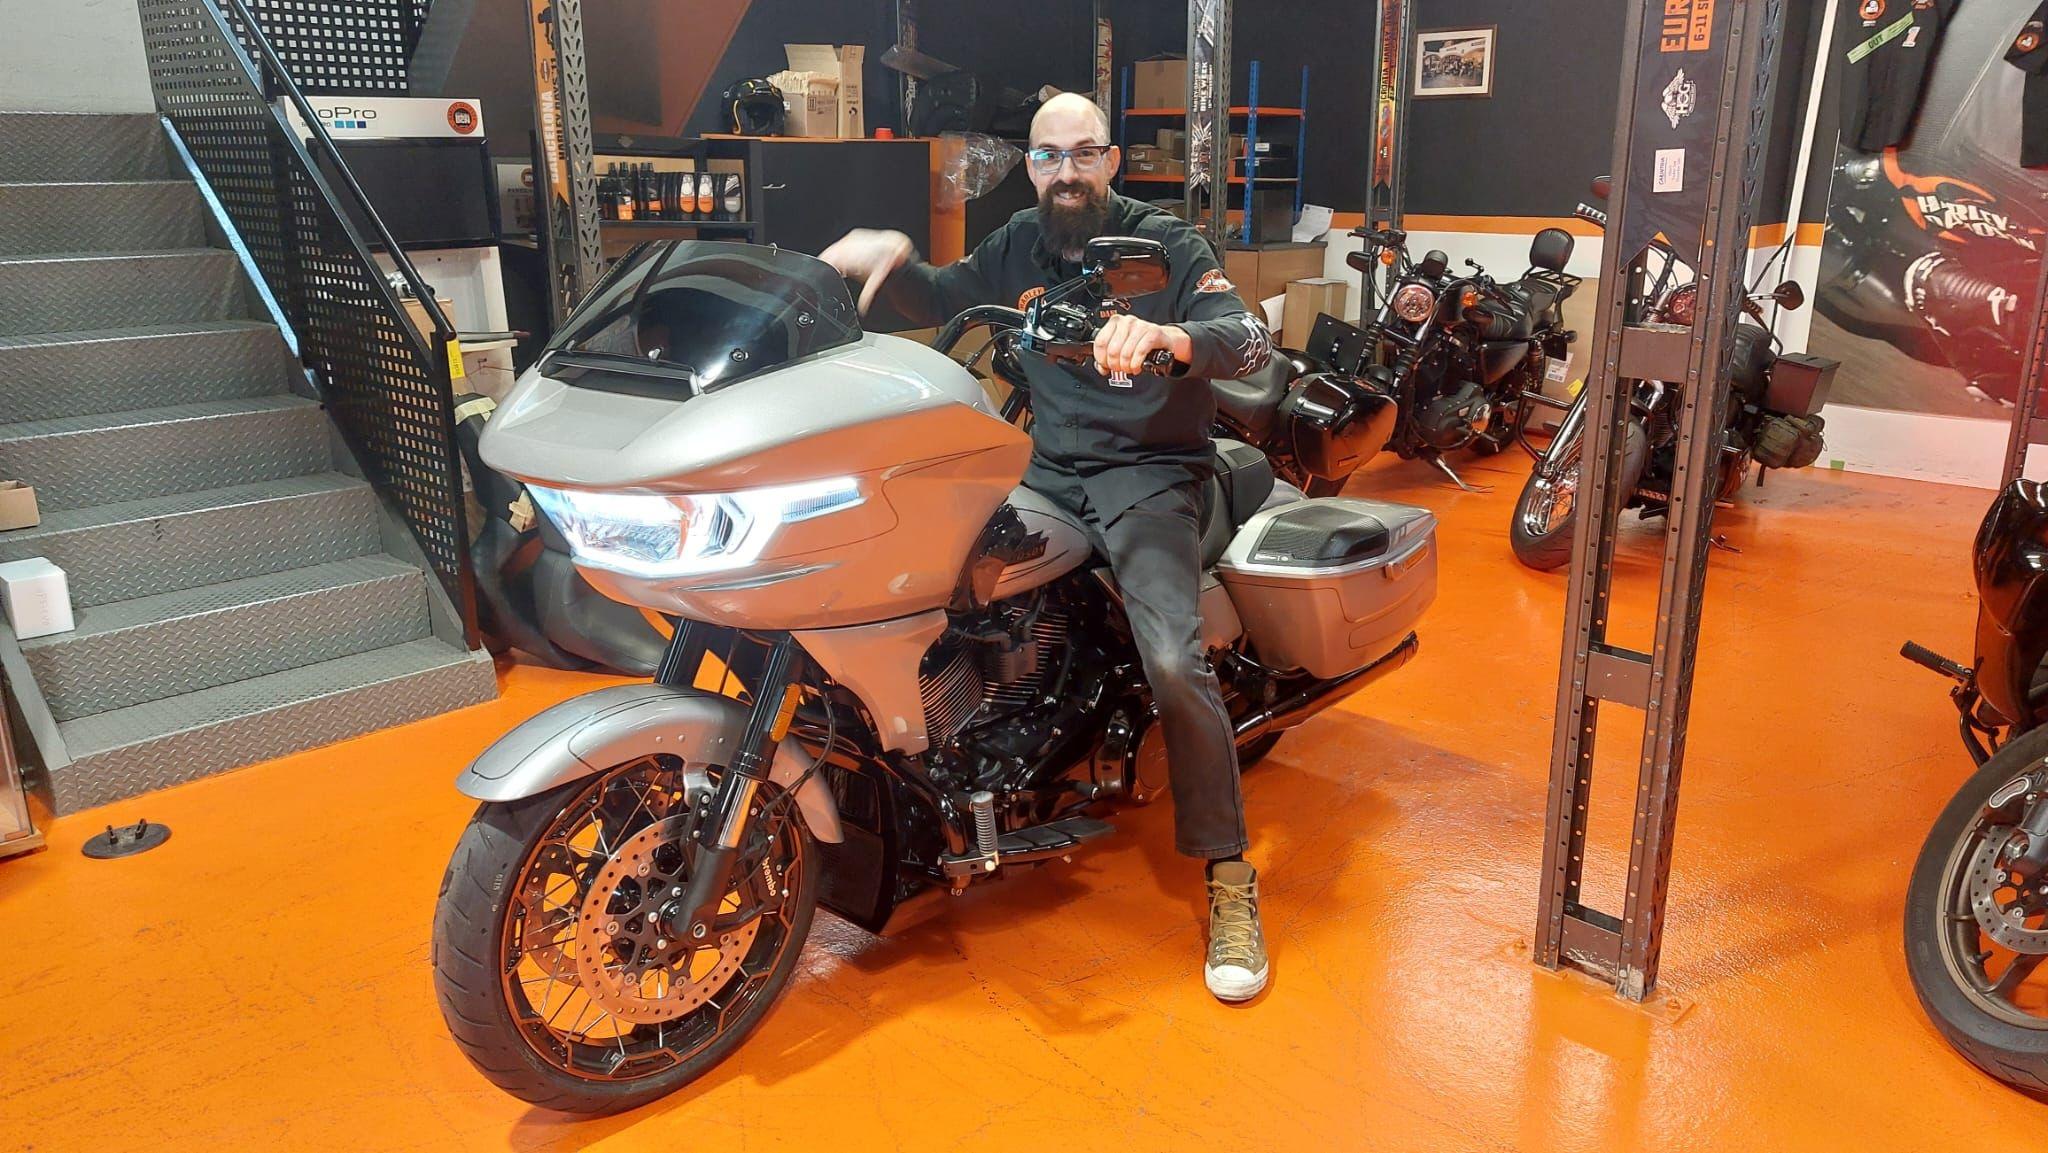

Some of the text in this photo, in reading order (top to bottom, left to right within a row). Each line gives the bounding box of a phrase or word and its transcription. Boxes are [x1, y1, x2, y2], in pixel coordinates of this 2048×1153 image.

[1694, 14, 1708, 41] 6-11
[304, 106, 377, 119] oPro
[541, 91, 560, 184] BARCELONA
[762, 856, 777, 897] brembo
